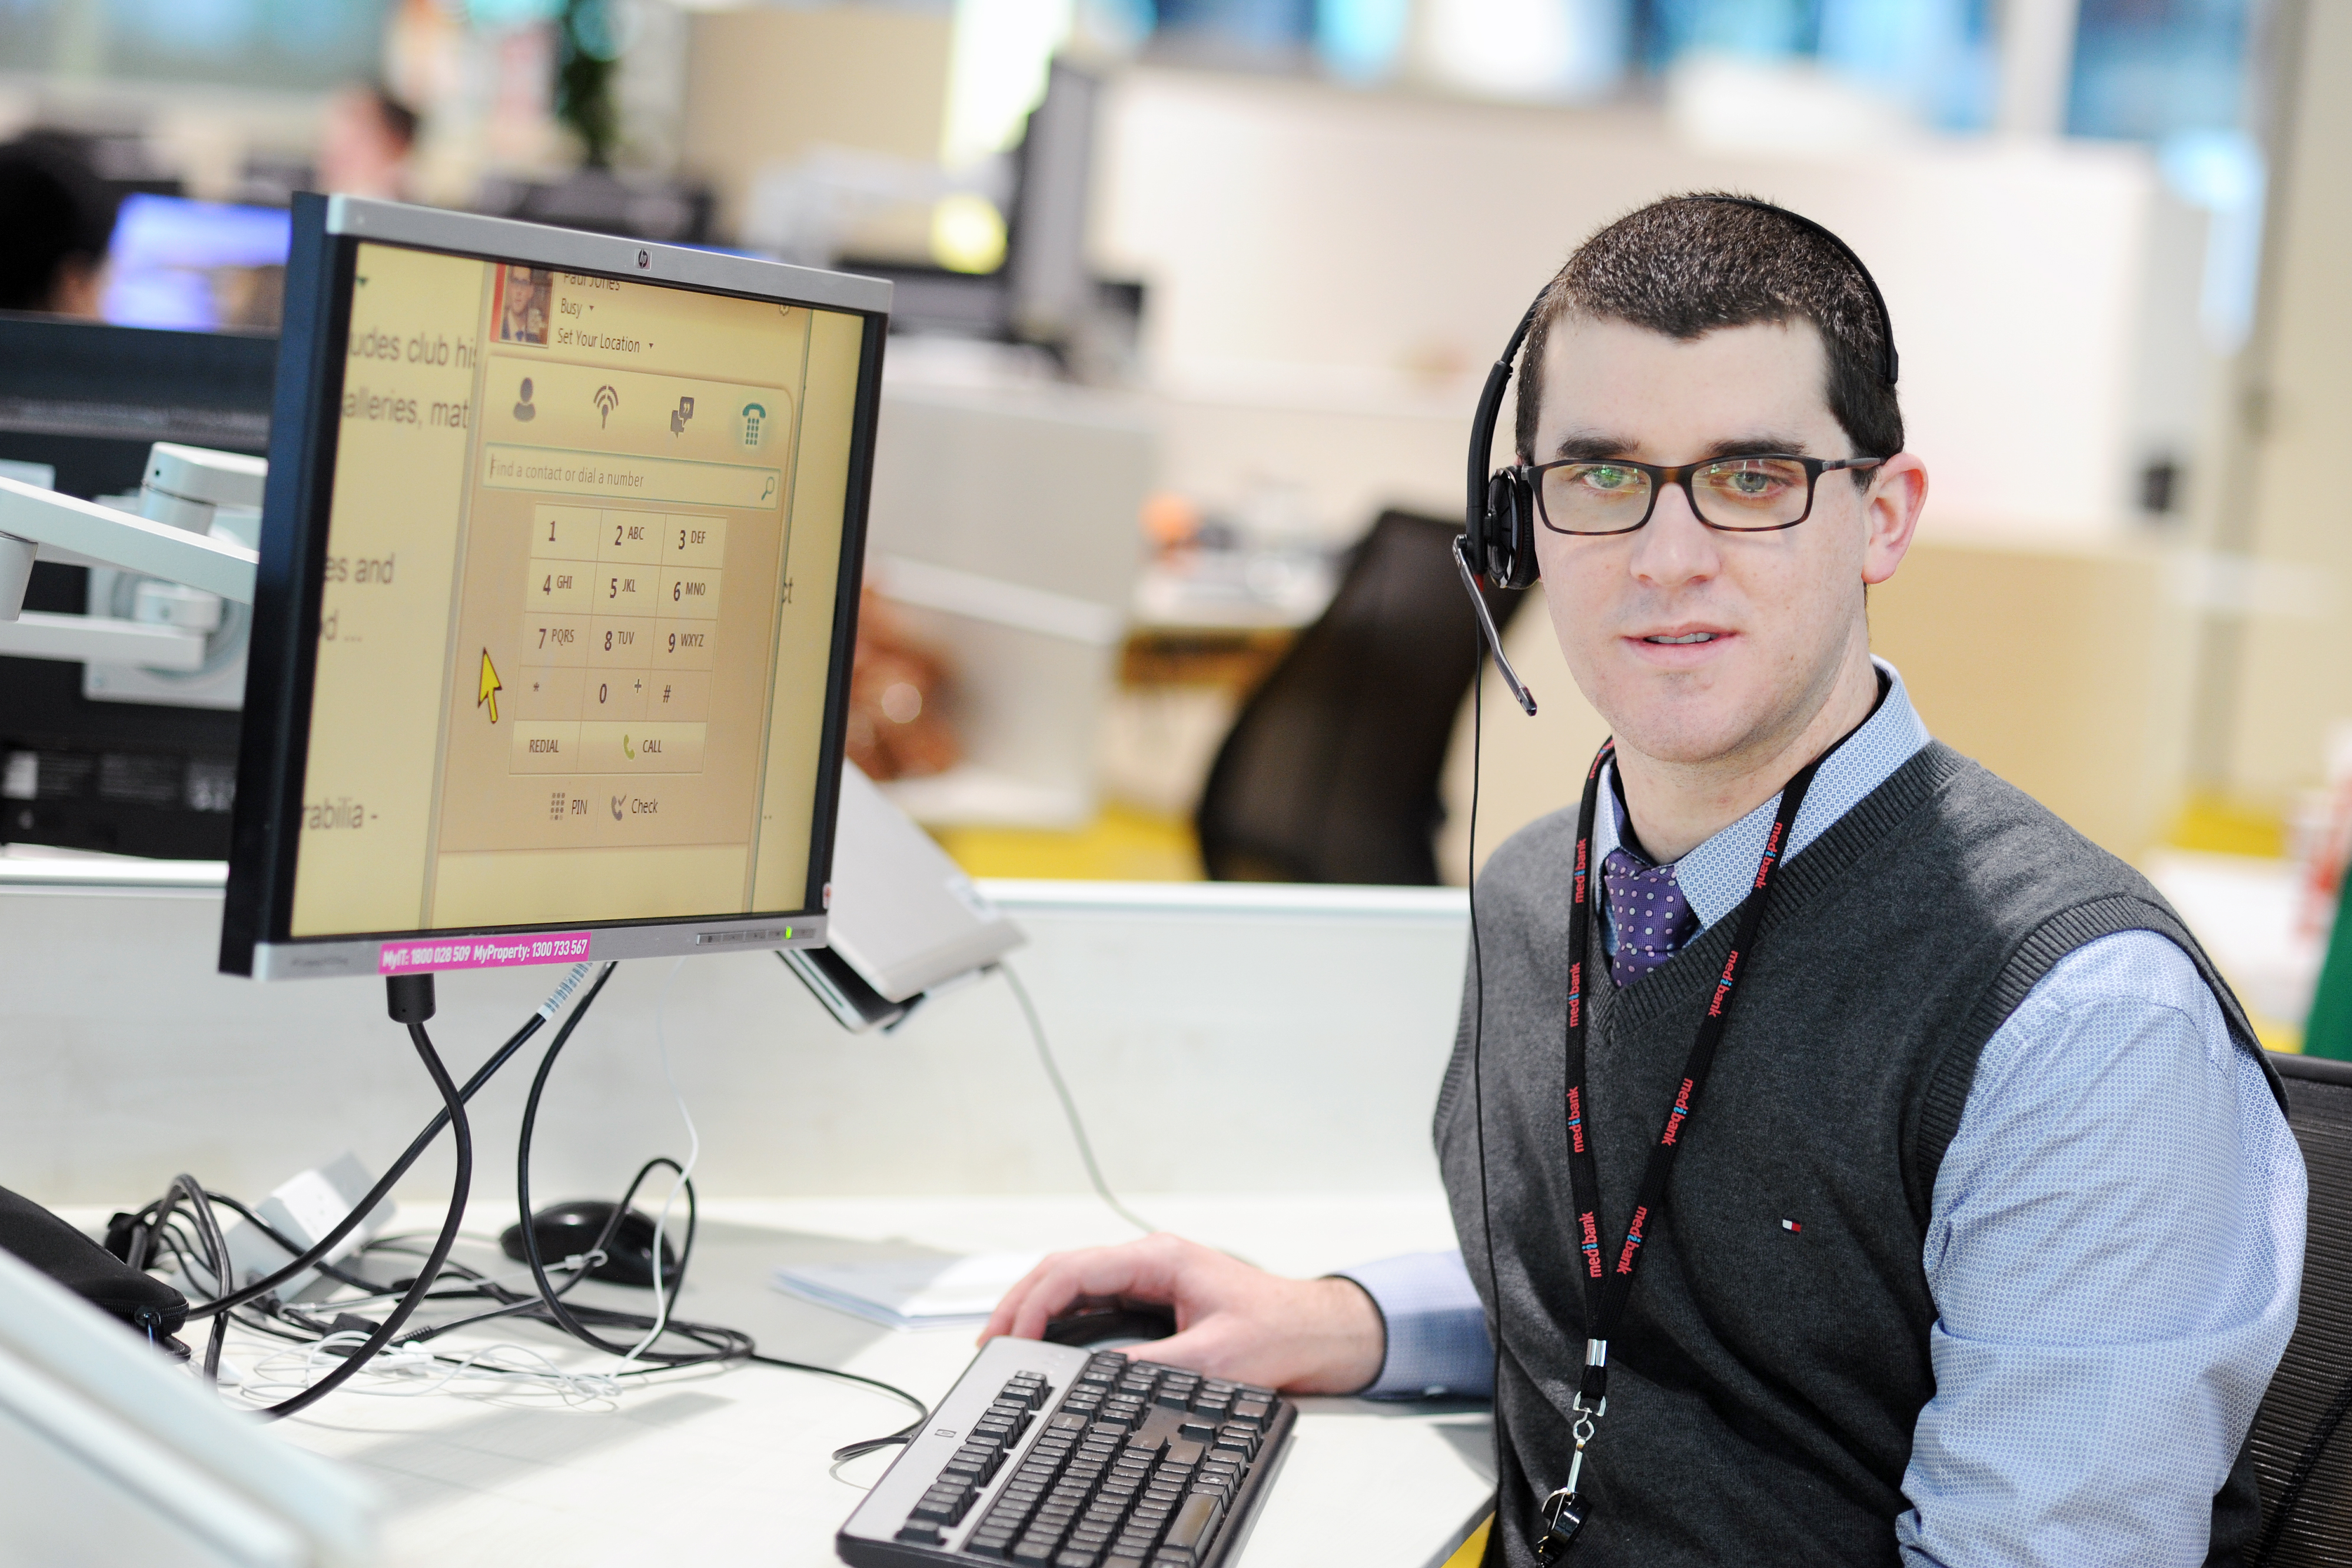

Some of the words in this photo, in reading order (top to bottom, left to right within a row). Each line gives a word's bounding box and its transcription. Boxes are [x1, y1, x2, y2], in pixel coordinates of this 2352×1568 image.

[560, 298, 583, 318] Busy
[407, 330, 449, 367] club
[557, 328, 573, 344] Set
[576, 330, 599, 347] Your
[600, 333, 640, 353] Location
[430, 399, 470, 429] mat
[491, 457, 514, 477] Find
[516, 465, 523, 477] a
[526, 465, 562, 481] contact
[565, 470, 576, 481] or
[578, 467, 596, 484] dial
[599, 473, 604, 484] a
[607, 470, 644, 487] number
[549, 520, 556, 542] 1
[614, 525, 623, 546] 2
[627, 526, 645, 540] ABC
[678, 530, 686, 550] 3
[690, 530, 706, 544] DEF
[355, 552, 396, 584] and
[543, 574, 552, 596] 4
[556, 575, 573, 589] GHI
[609, 577, 617, 599] 5
[622, 579, 636, 593] JKL
[673, 582, 681, 602] 6
[685, 582, 706, 596] MNO
[539, 628, 547, 649] 7
[551, 629, 575, 646] PQRS
[604, 630, 613, 651] 8
[617, 631, 634, 645] TUV
[668, 633, 676, 653] 9
[680, 633, 705, 647] WXYZ
[599, 683, 607, 704] 0
[663, 685, 672, 703] #
[529, 739, 559, 753] REDIAL
[642, 739, 662, 753] CALL
[571, 799, 588, 815] PIN
[631, 798, 659, 815] Check
[1754, 822, 1783, 889] medibank
[1574, 838, 1587, 903] medibank
[383, 949, 409, 970] MyIT:
[411, 948, 434, 965] 1800
[434, 946, 453, 964] 028
[453, 945, 471, 962] 509
[473, 944, 530, 964] MyProperty:
[532, 941, 553, 957] 1300
[553, 939, 570, 956] 733
[570, 939, 588, 955] 567
[1569, 962, 1580, 1028] medibank
[1708, 950, 1739, 1018] medibank
[1566, 1086, 1584, 1153] medibank
[1662, 1077, 1693, 1147] medibank
[1579, 1211, 1602, 1278] medibank
[1617, 1206, 1647, 1275] medibank
